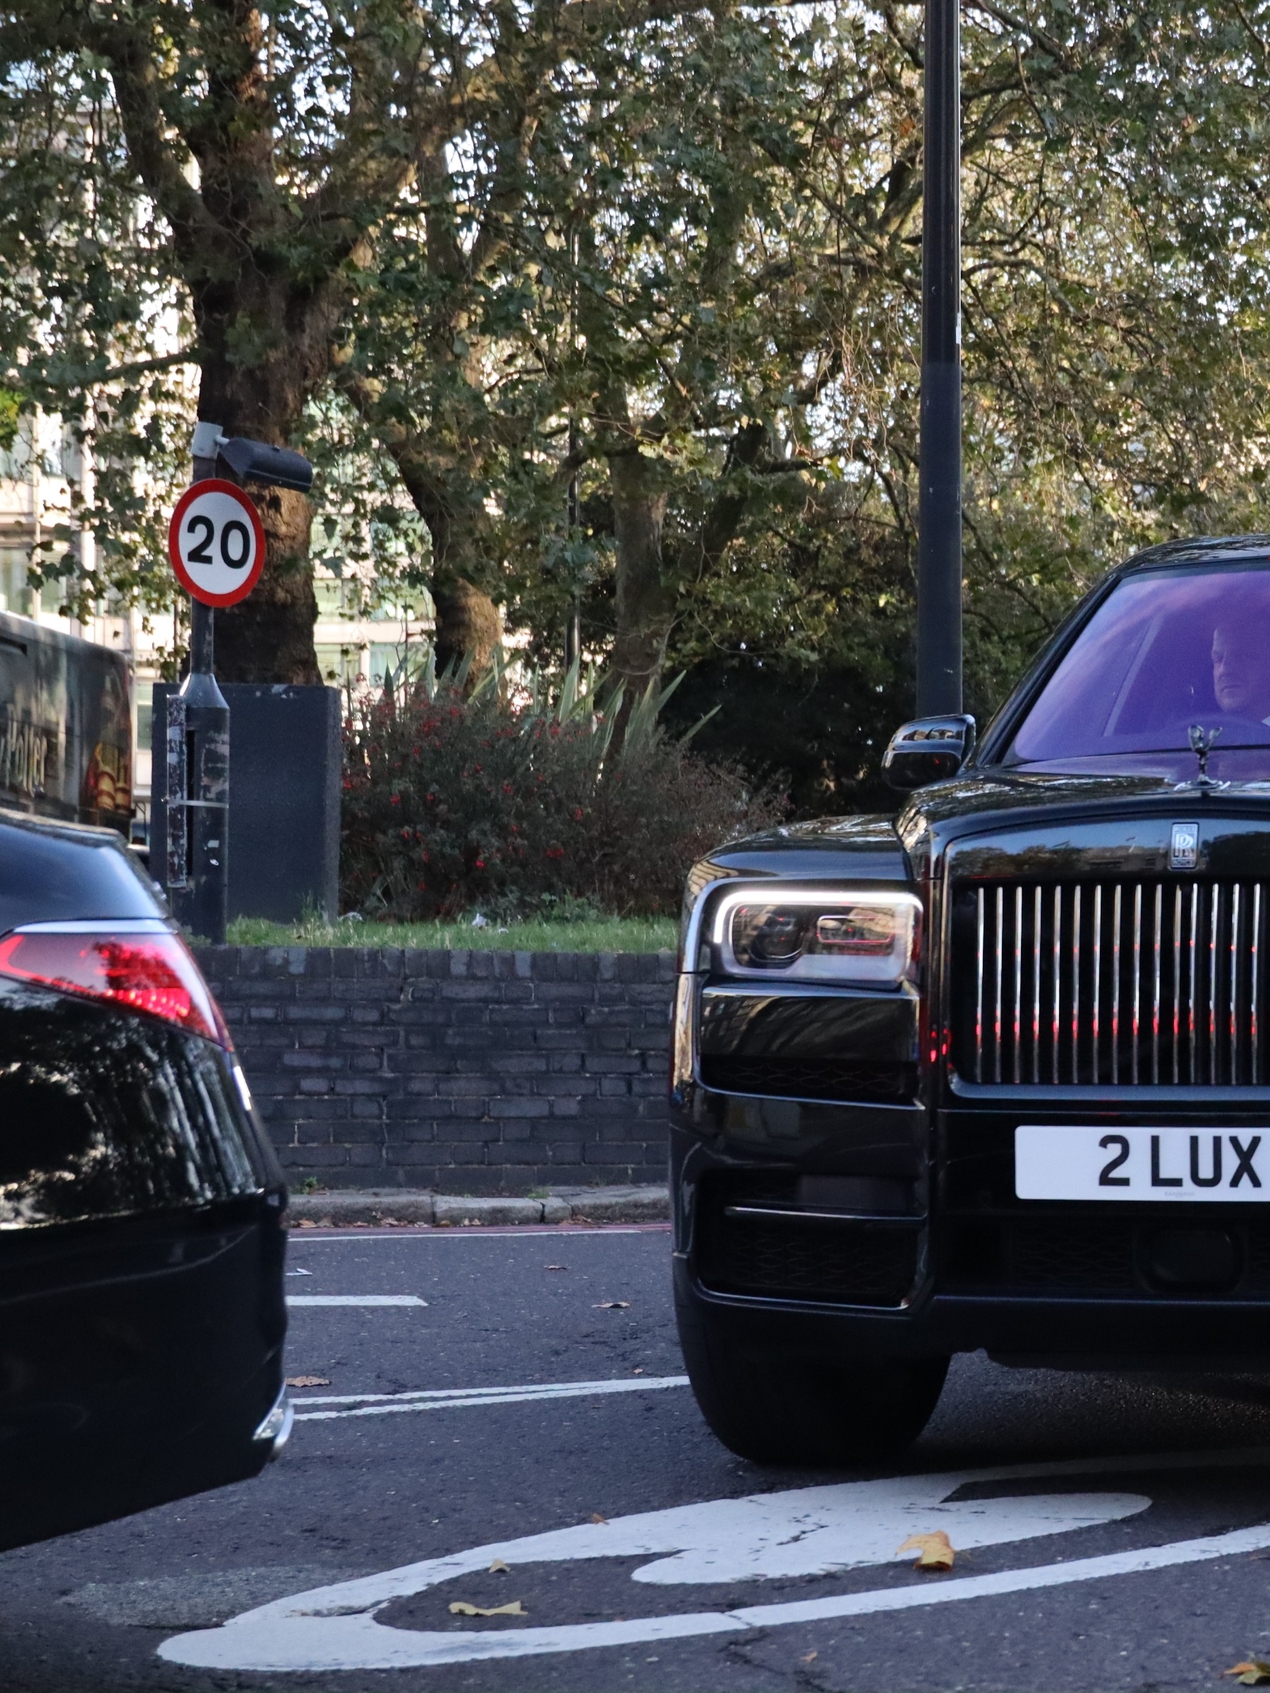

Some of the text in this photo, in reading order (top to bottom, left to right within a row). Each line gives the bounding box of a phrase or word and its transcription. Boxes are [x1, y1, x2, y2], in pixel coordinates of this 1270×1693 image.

[186, 514, 251, 570] 20
[1098, 1134, 1262, 1188] 2 LUX
